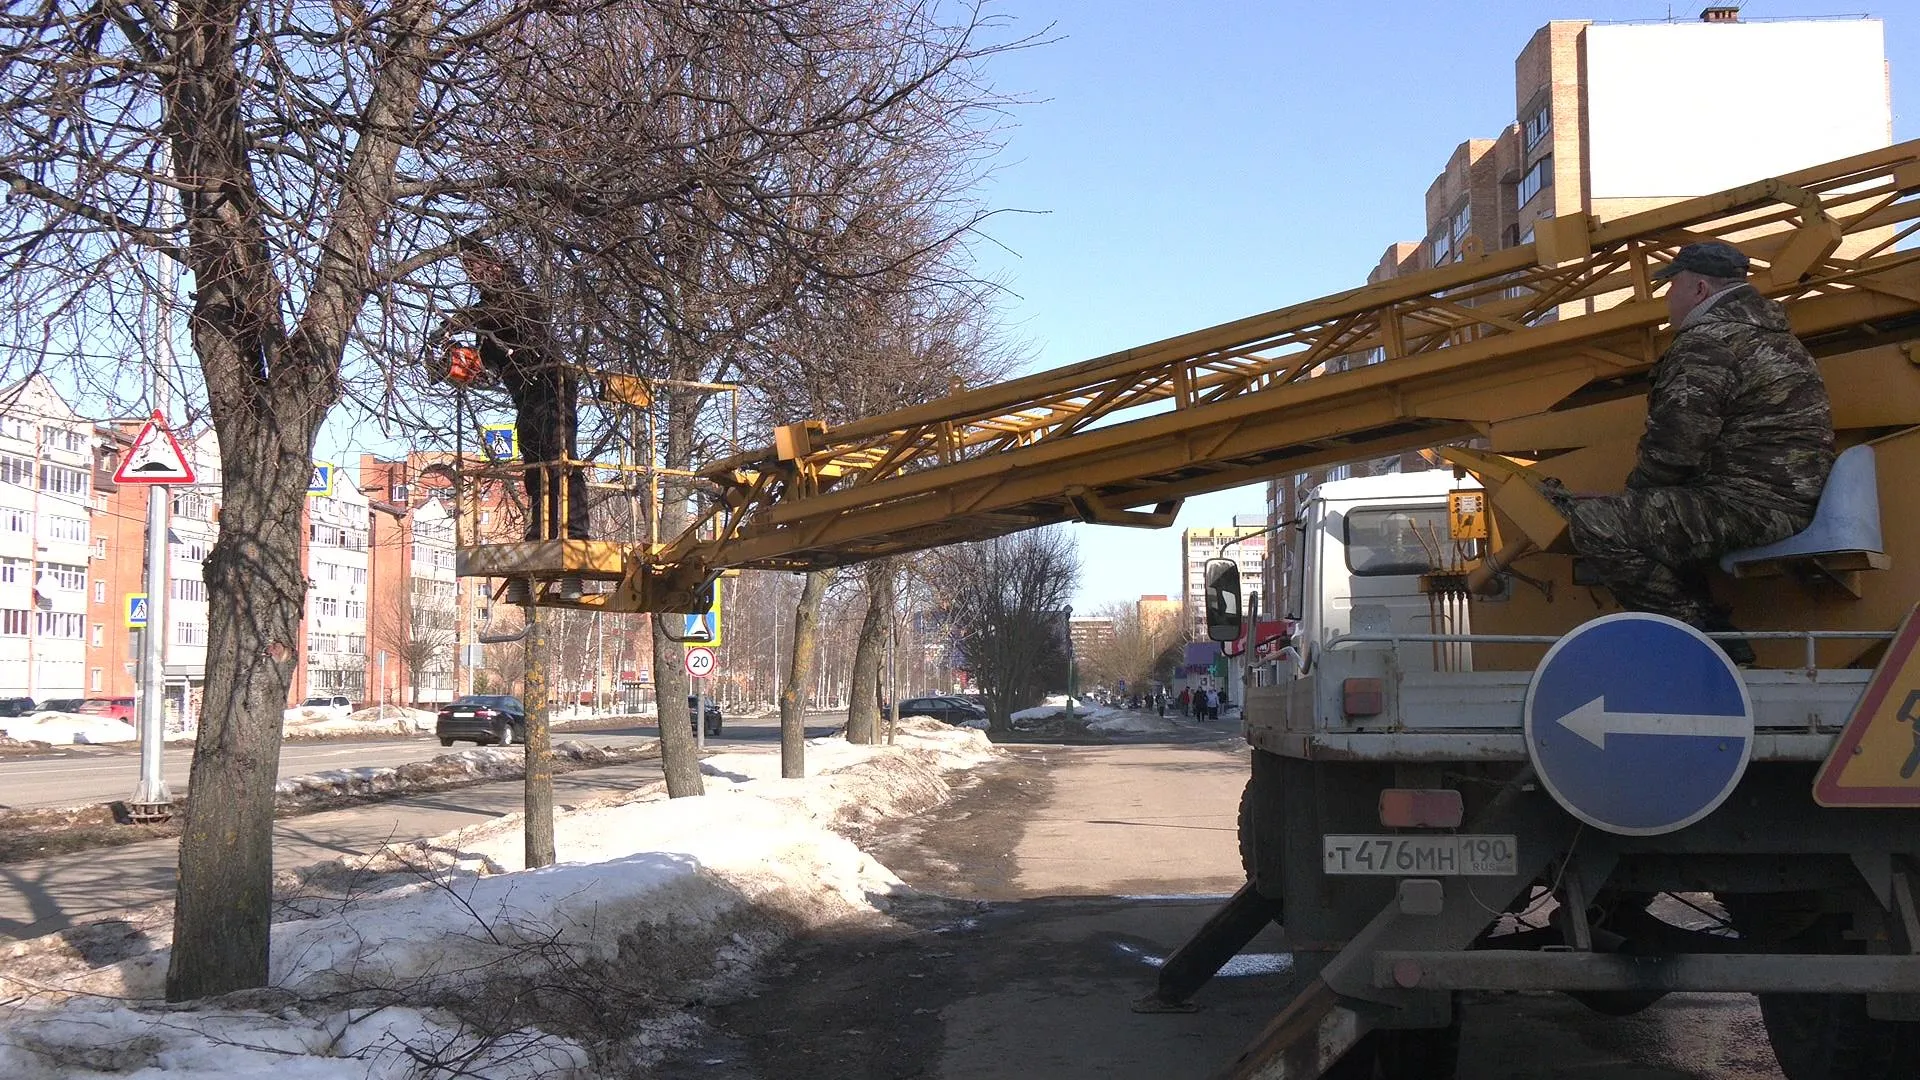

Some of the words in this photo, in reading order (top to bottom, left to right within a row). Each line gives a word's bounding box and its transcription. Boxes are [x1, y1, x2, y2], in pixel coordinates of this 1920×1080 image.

[693, 656, 708, 667] 20
[1335, 840, 1454, 870] Т476МН
[1463, 840, 1507, 862] 190
[1472, 862, 1496, 872] RUS
